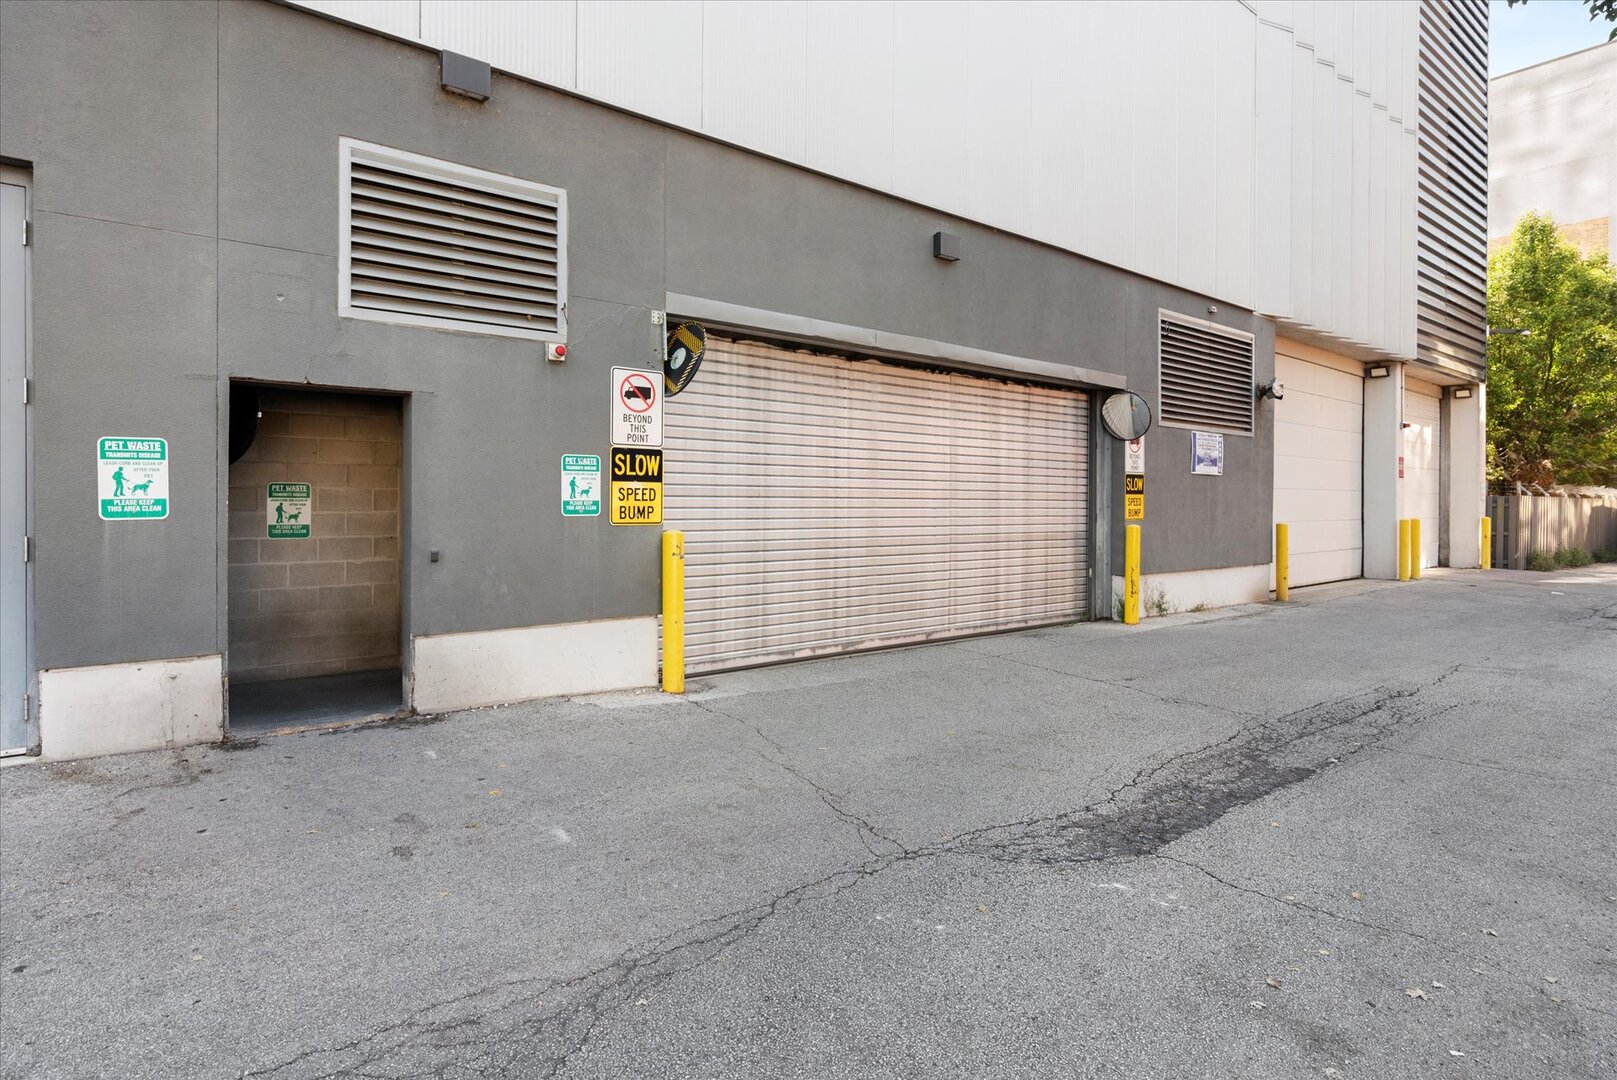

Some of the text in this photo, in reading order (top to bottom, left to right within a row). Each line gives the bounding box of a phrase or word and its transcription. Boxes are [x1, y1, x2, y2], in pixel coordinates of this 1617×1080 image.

[623, 414, 653, 424] BEYOND
[630, 424, 646, 433] THIS
[627, 434, 649, 443] POINT
[104, 441, 162, 450] PET WASTE
[614, 454, 660, 476] SLOW
[1126, 478, 1144, 491] SLOW
[618, 487, 656, 502] SPEED
[1128, 498, 1142, 506] SPEED
[619, 506, 654, 520] BUMP
[1128, 508, 1141, 517] BUMP
